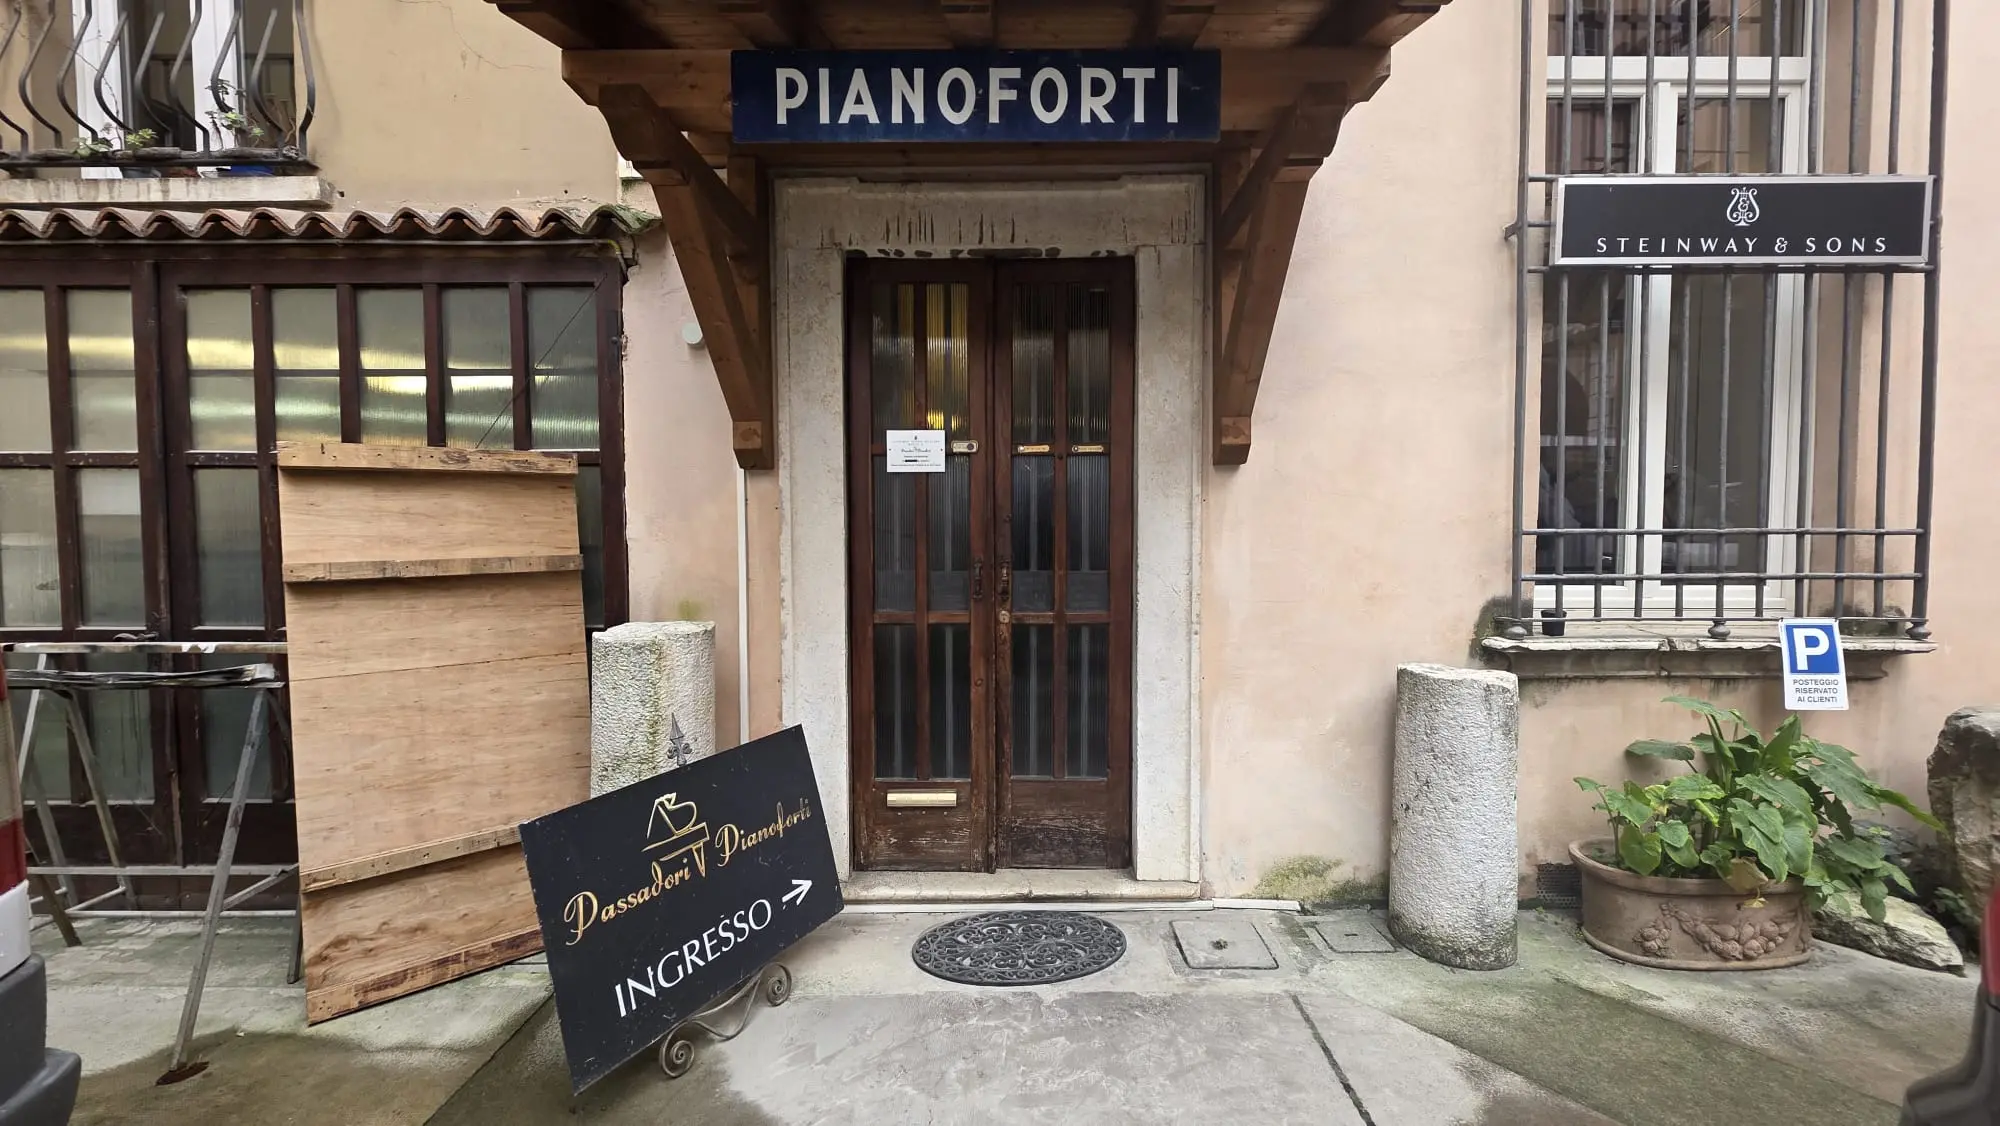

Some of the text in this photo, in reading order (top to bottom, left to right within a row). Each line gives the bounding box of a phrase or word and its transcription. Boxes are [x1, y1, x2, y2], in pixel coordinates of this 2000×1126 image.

[775, 66, 1179, 125] PIANOFORTI
[1596, 237, 1888, 254] STEINWAY & SONS
[1792, 627, 1830, 671] P
[563, 798, 812, 946] Passadori Pianoforti
[613, 898, 772, 1018] INGRESSO
